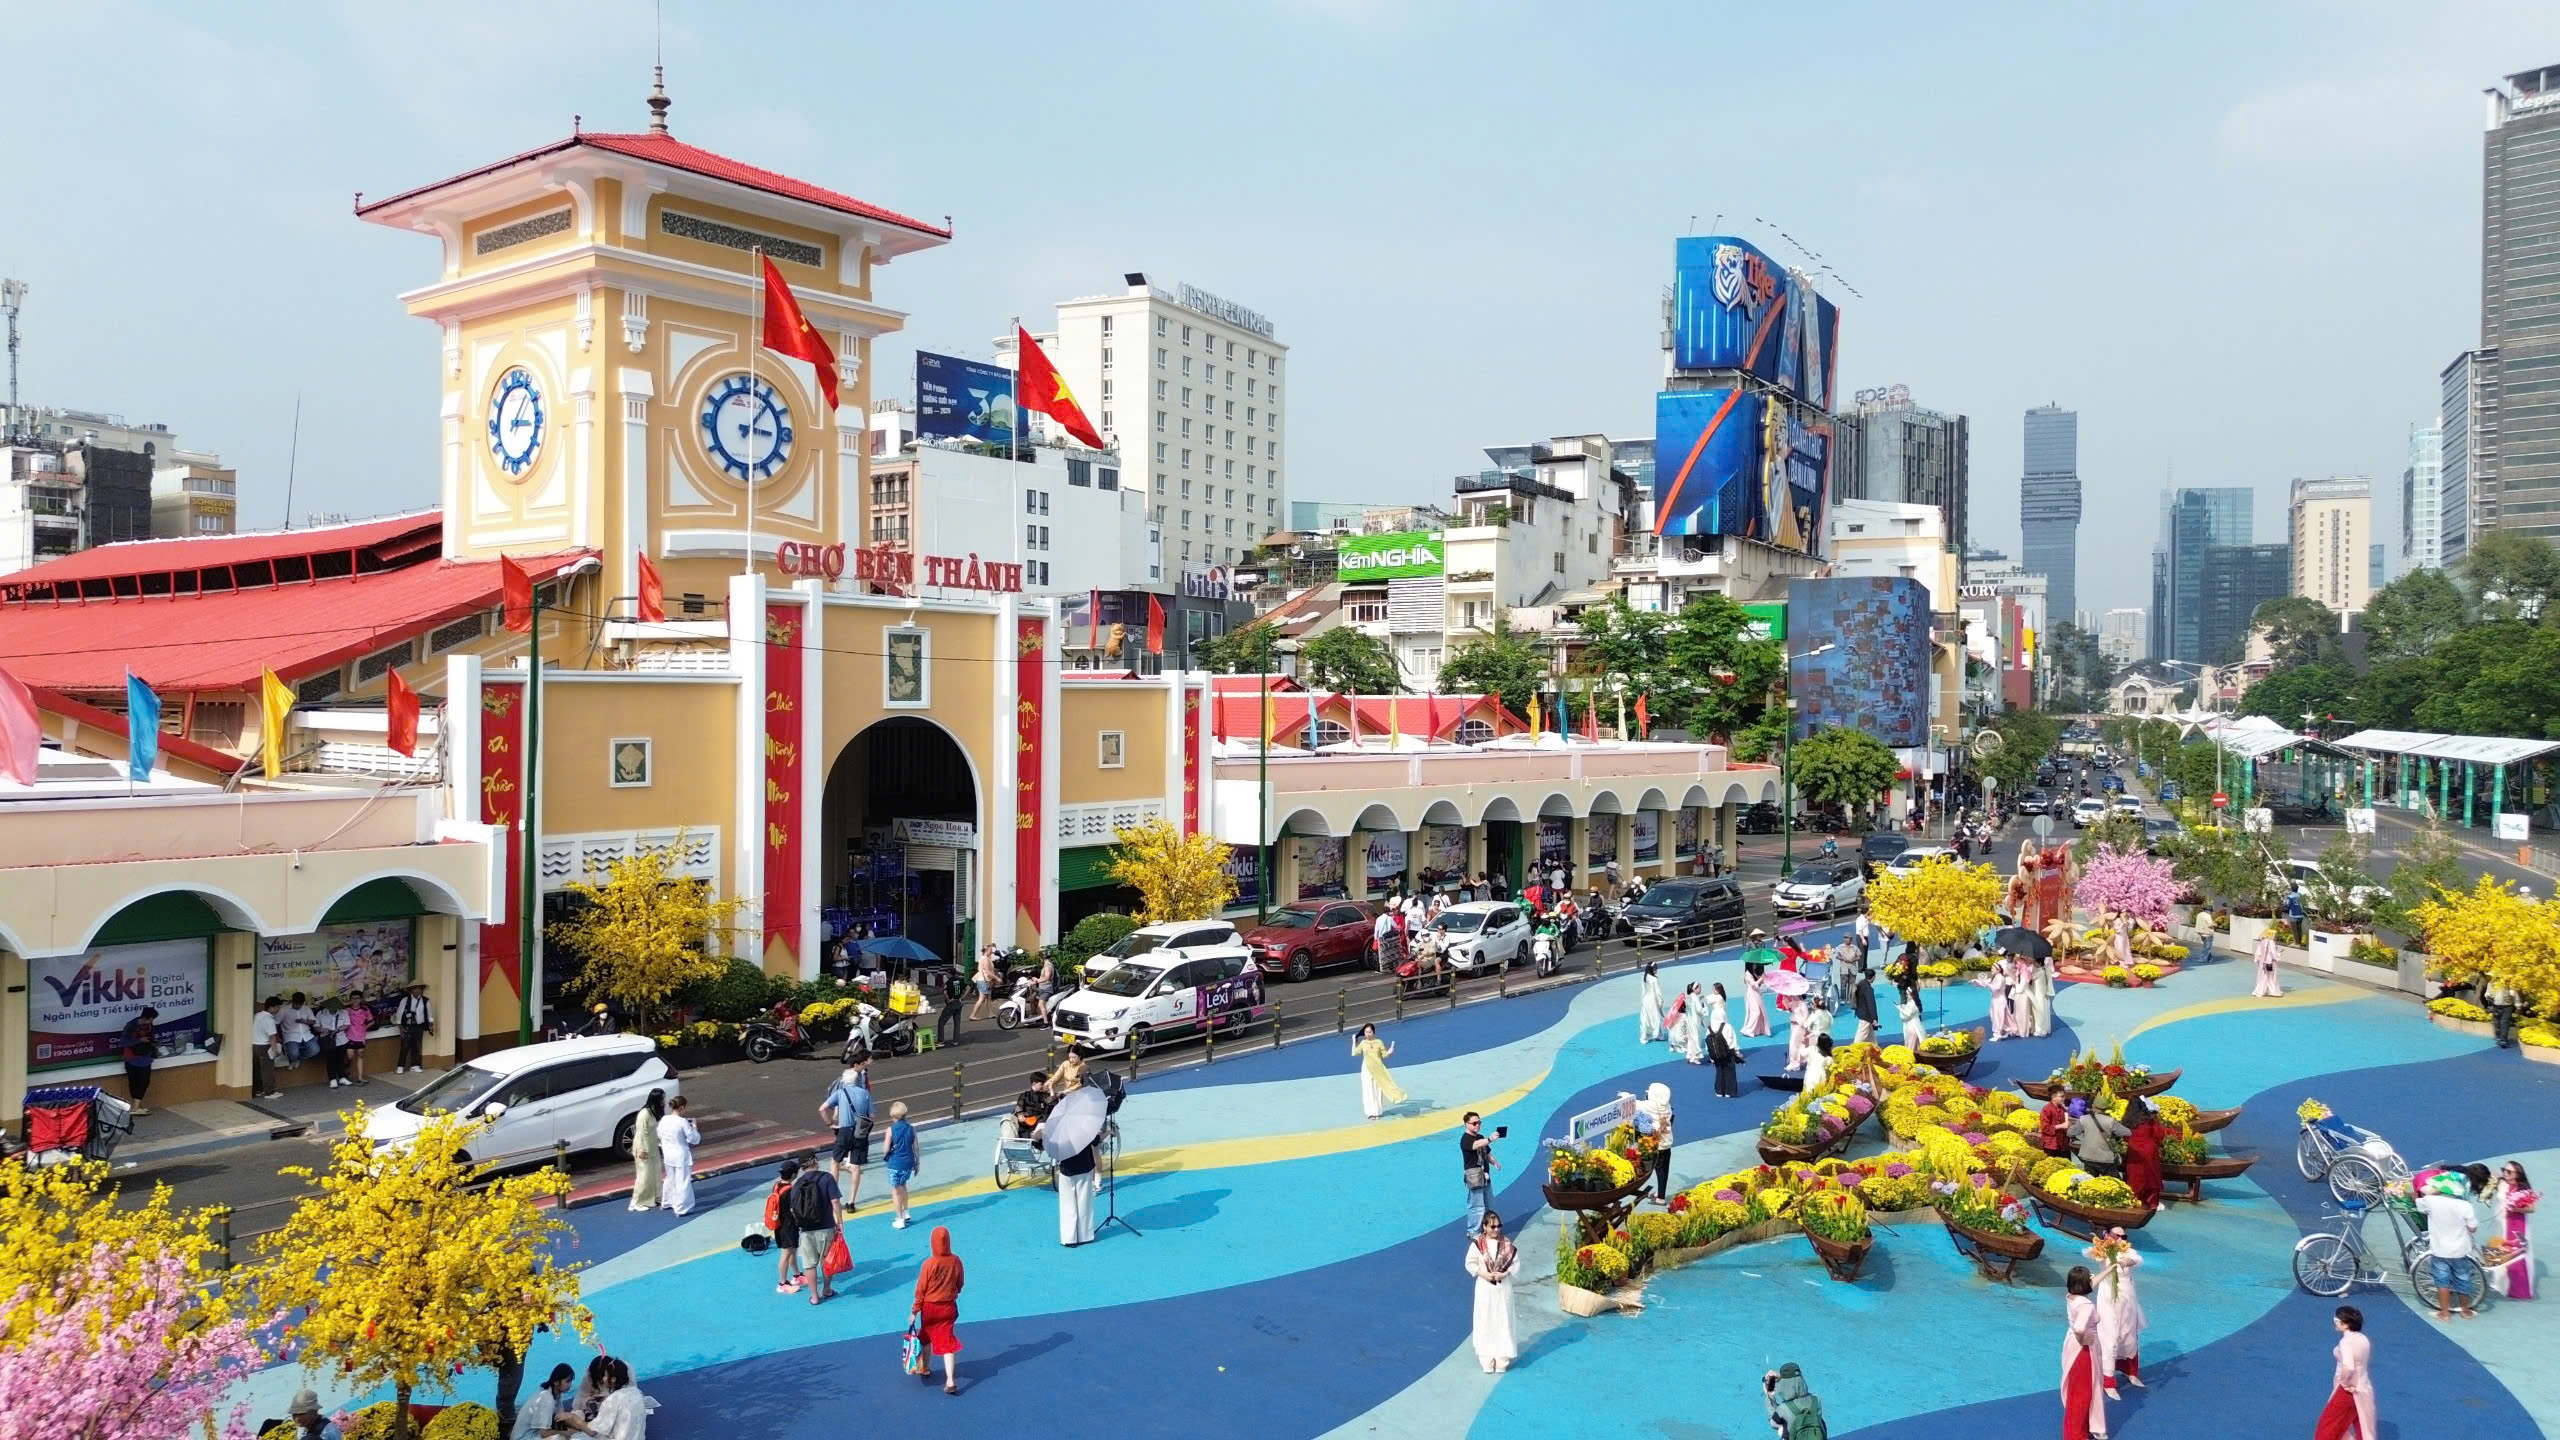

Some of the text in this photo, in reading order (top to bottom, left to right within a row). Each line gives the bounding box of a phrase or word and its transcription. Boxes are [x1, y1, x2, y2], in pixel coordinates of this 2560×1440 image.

[776, 540, 1023, 593] CHỢ BẾN THÀNH
[764, 691, 794, 713] Chúc
[1016, 693, 1040, 728] appy
[264, 937, 292, 952] Vikki
[43, 953, 145, 1008] Vikki
[151, 973, 185, 984] Digital
[151, 981, 195, 998] Bank
[43, 997, 194, 1023] Ngân hàng Tiết kiệm Tốt nhất!
[53, 1049, 72, 1057] 1900
[1585, 1113, 1607, 1131] KHANG
